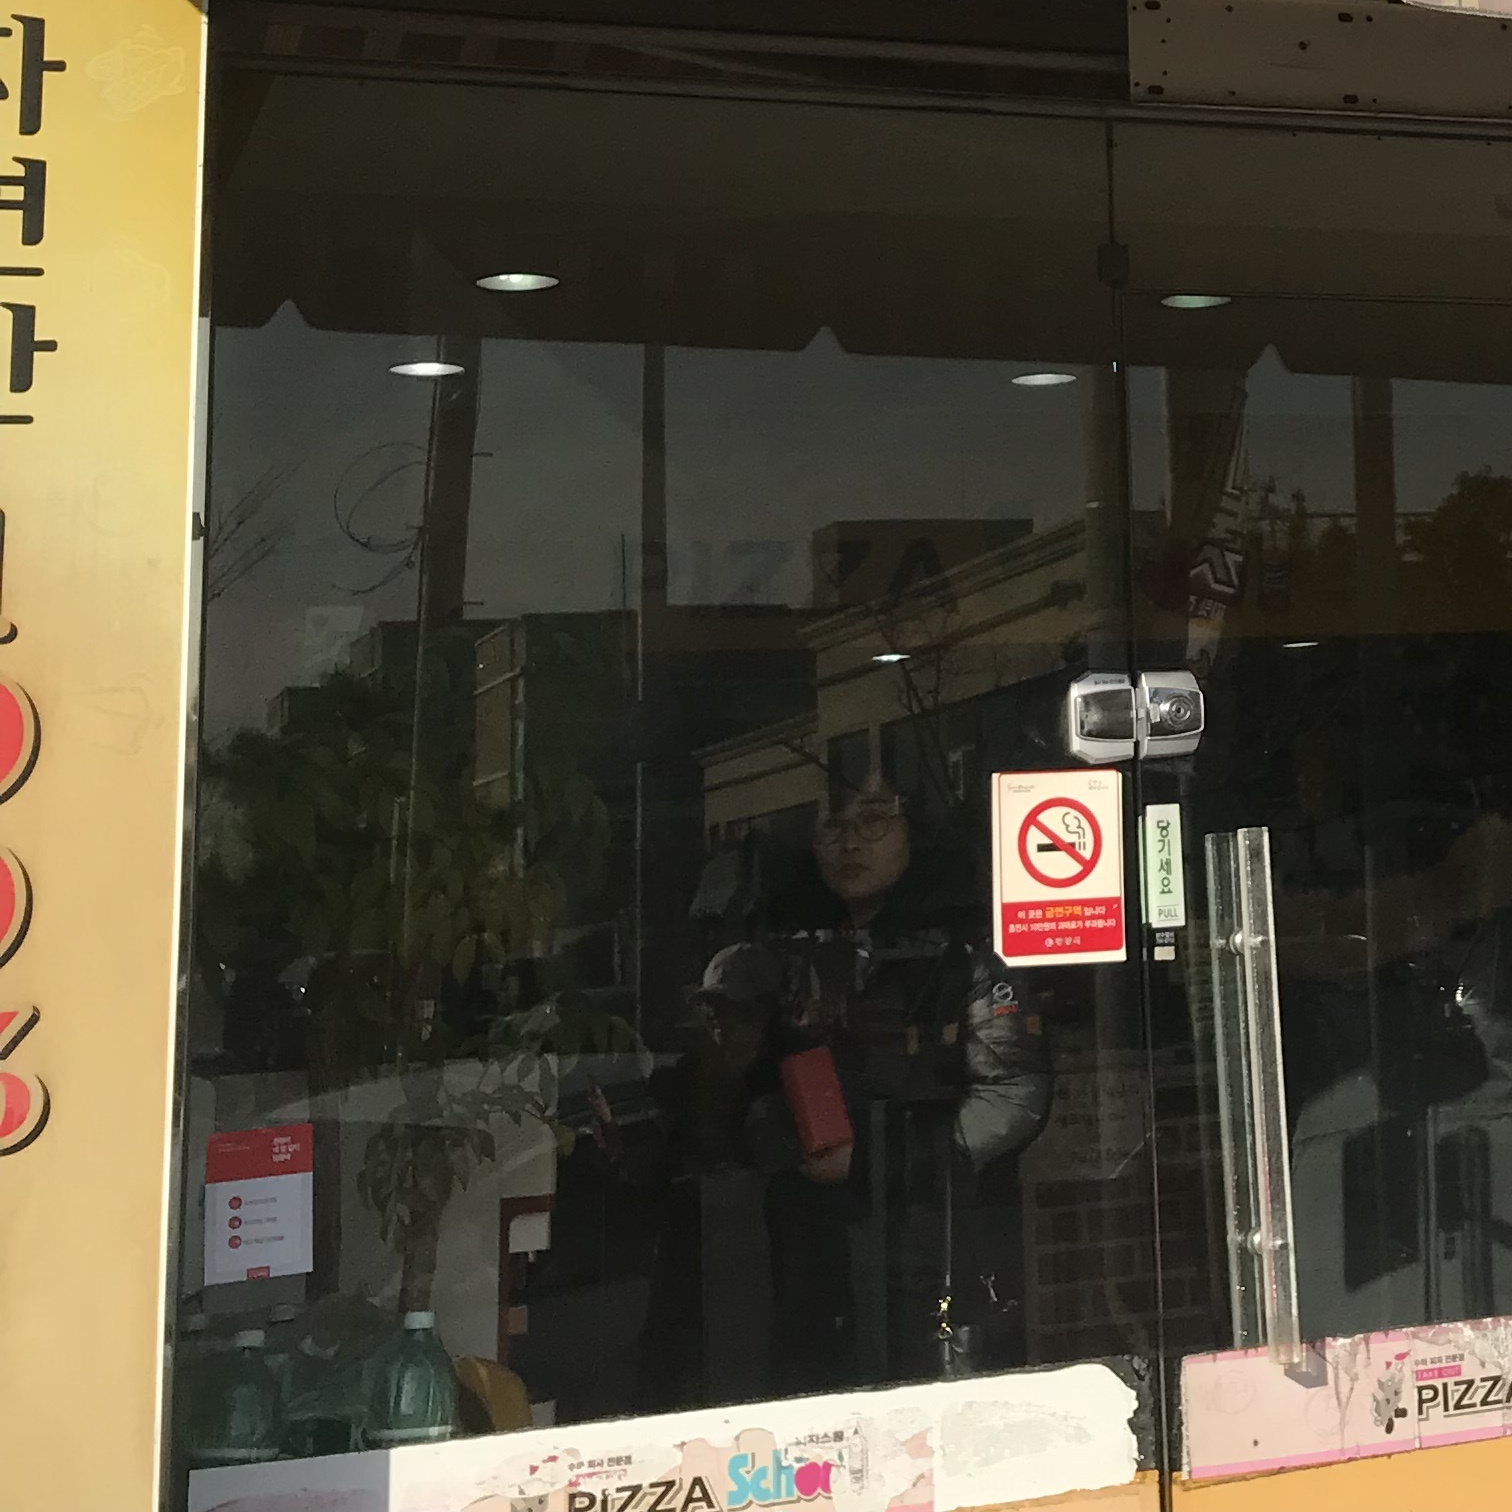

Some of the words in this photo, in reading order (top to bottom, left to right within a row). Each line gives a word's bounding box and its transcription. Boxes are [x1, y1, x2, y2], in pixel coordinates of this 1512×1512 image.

[1156, 819, 1173, 894] 당기세요
[1045, 905, 1082, 919] 금연구역
[1158, 908, 1178, 919] PULL
